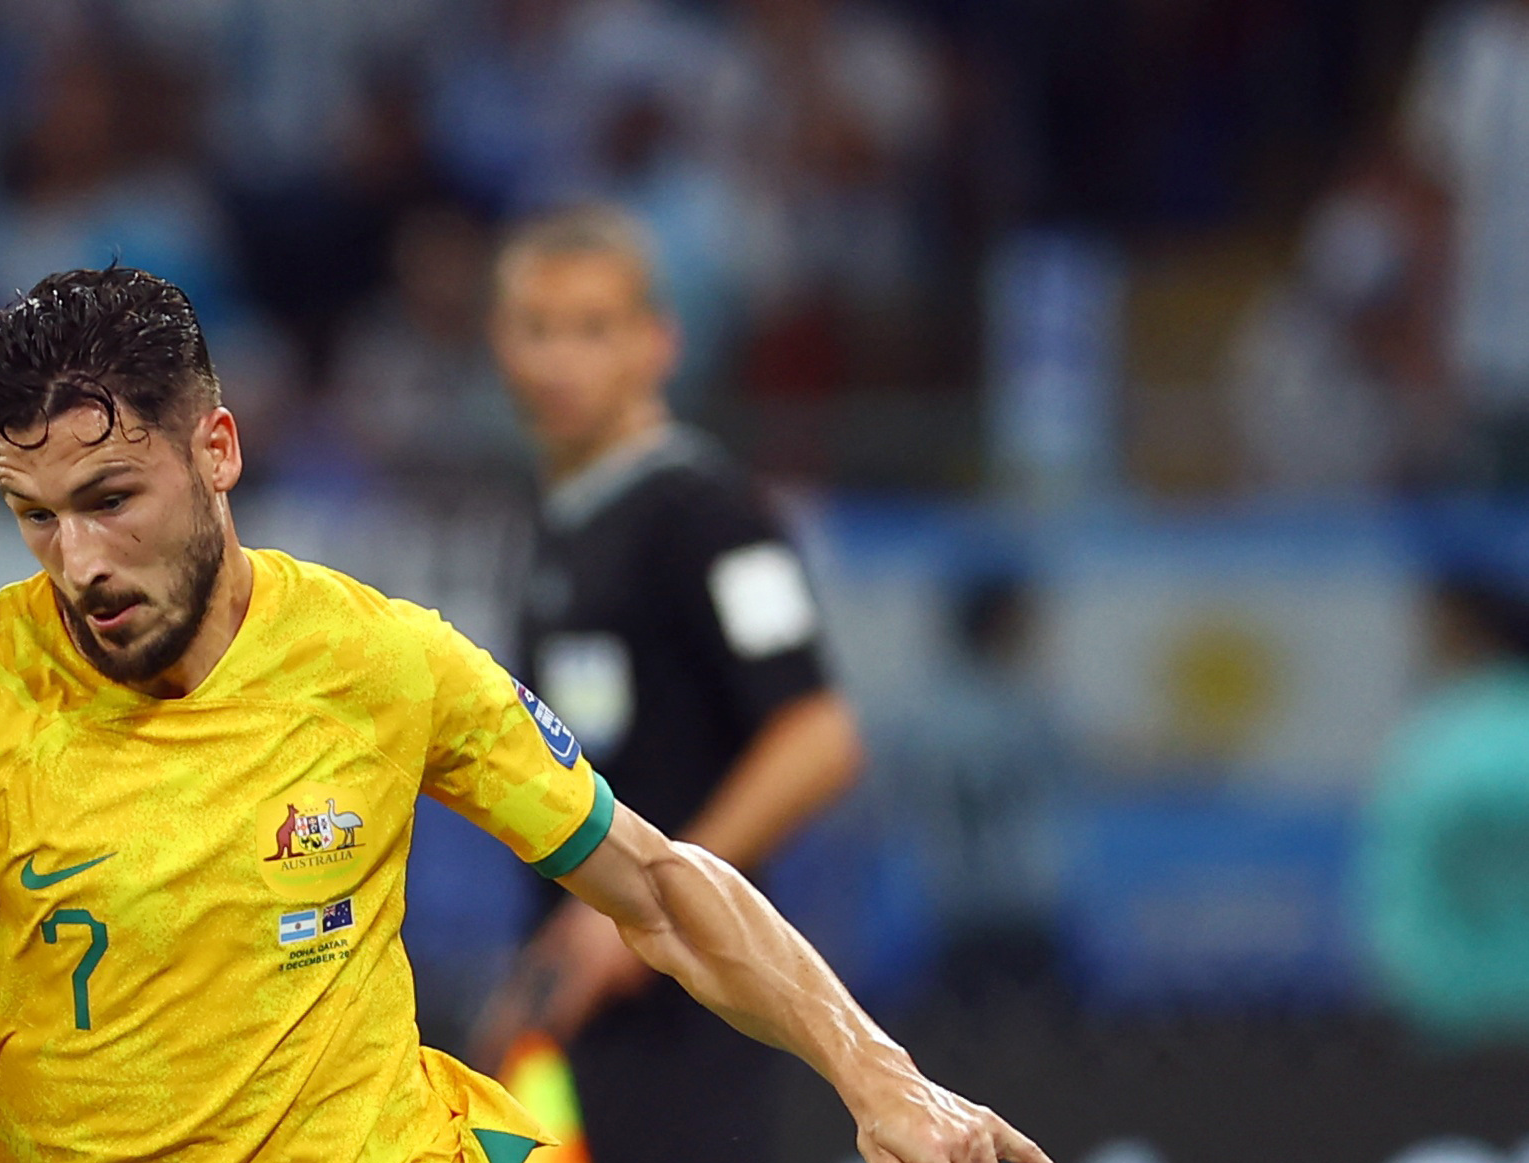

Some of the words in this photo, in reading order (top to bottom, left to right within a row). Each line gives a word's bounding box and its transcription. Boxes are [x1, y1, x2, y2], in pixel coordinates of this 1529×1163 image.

[281, 850, 354, 872] AUSTRALIA
[41, 909, 109, 1031] 7
[286, 954, 336, 970] DECEMBER
